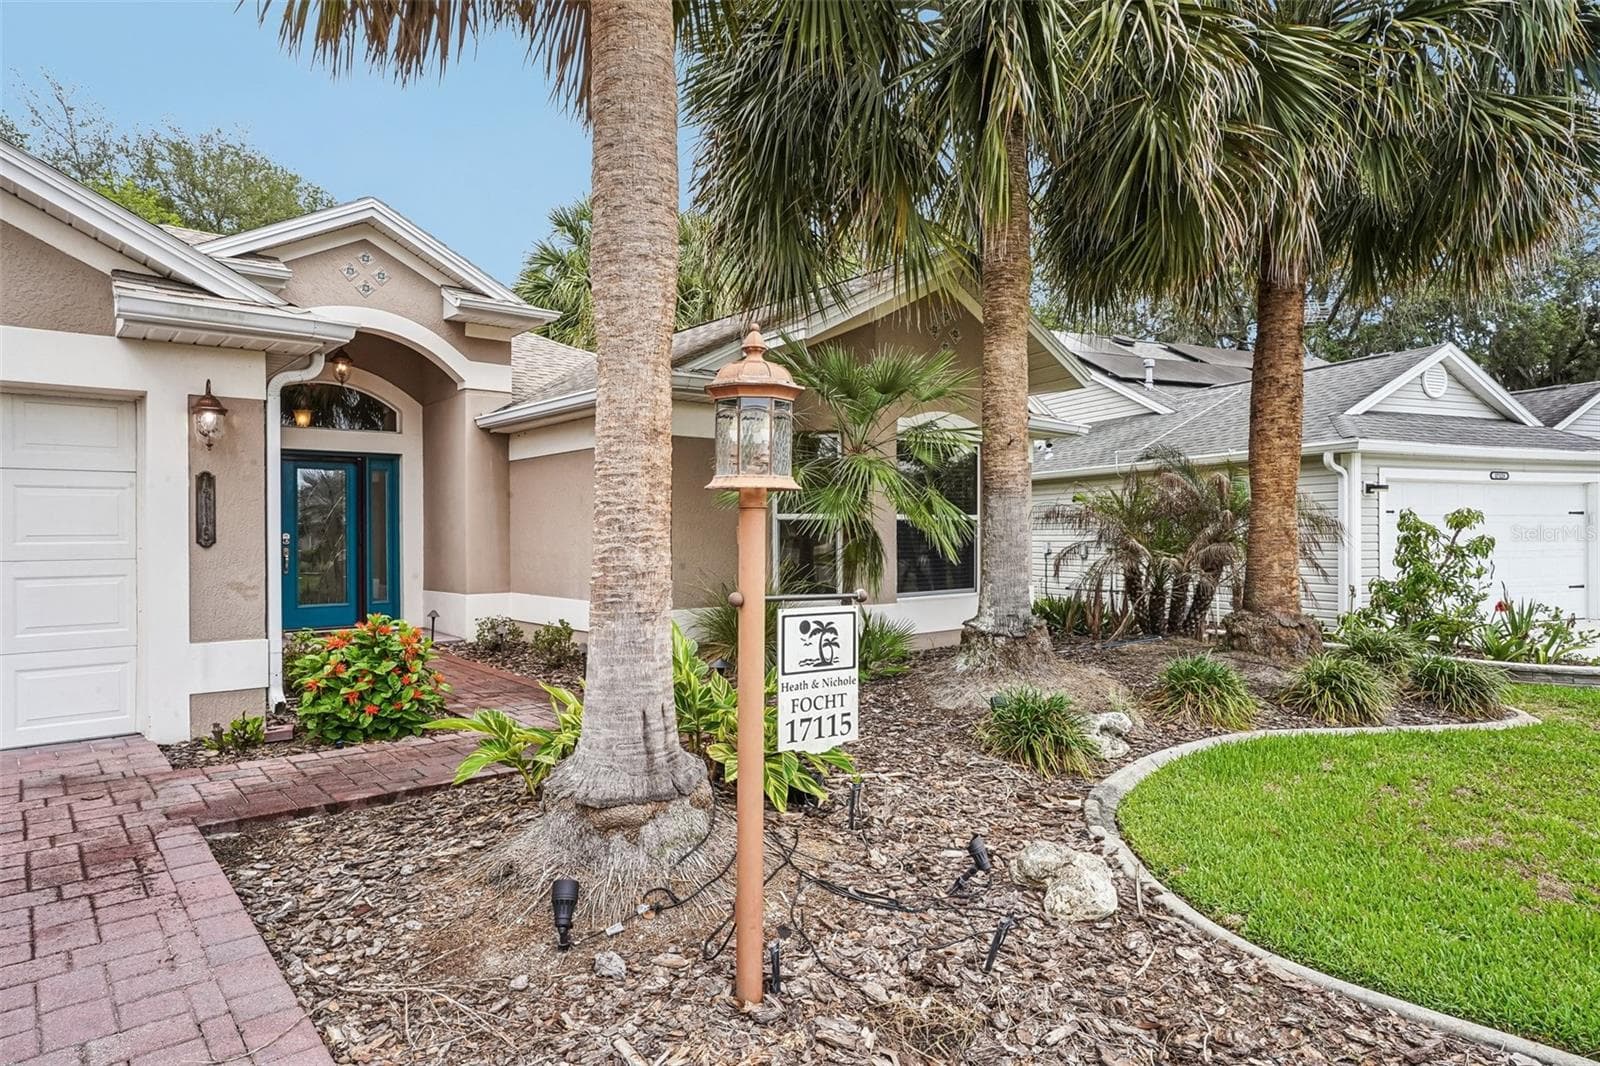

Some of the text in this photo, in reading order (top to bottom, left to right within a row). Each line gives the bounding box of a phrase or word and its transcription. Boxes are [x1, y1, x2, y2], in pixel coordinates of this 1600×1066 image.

[781, 676, 857, 692] Heath & Nichole
[791, 692, 847, 713] FOCHT
[785, 712, 852, 744] 17115
